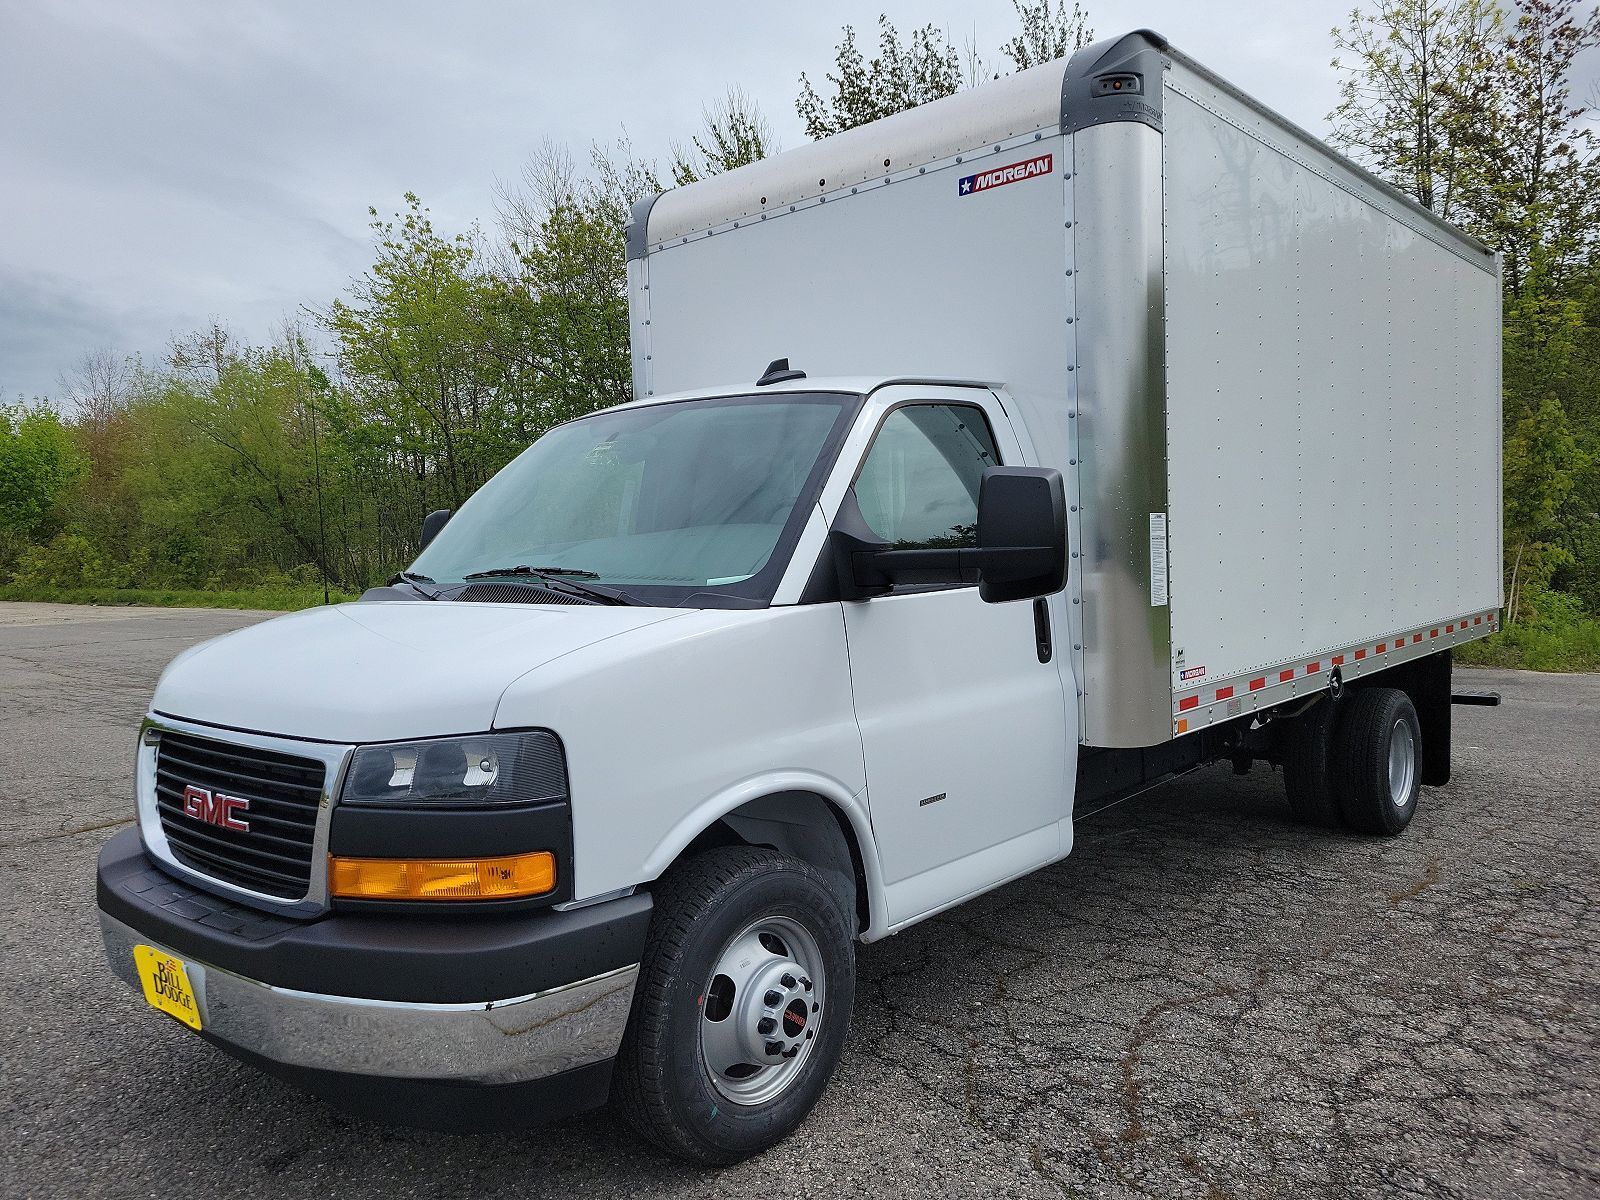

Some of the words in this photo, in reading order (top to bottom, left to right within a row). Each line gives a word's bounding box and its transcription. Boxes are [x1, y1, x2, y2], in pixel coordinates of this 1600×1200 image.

[975, 158, 1049, 191] MORGAN
[184, 784, 250, 833] GMC
[153, 972, 193, 1011] DODGE
[157, 960, 183, 991] BILL
